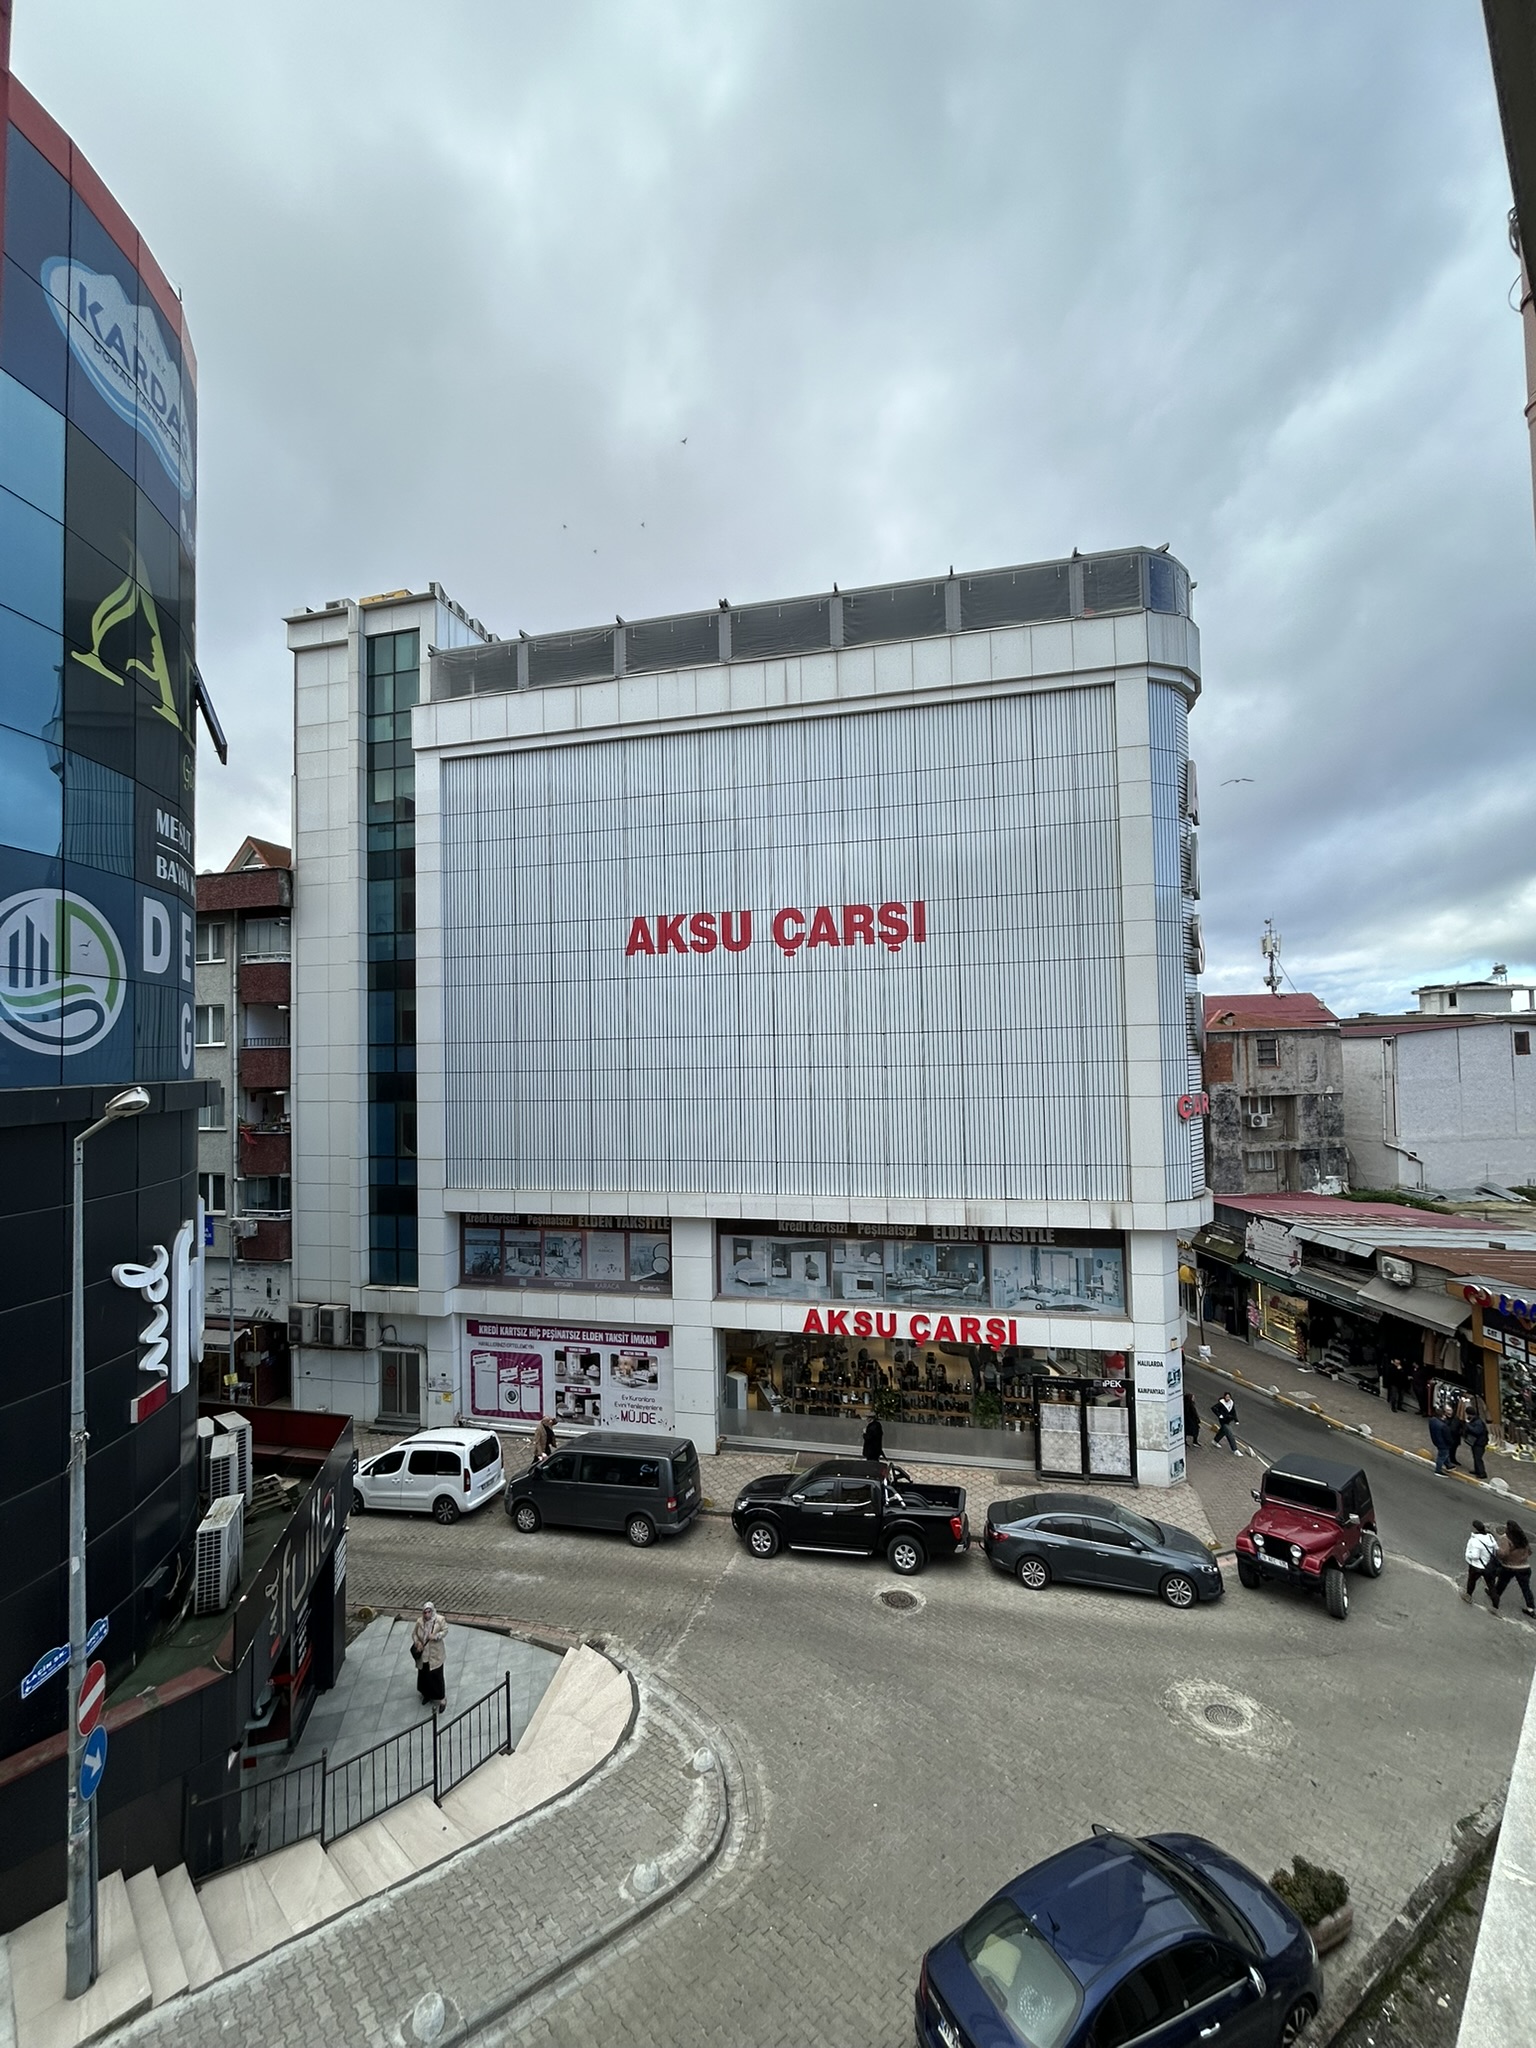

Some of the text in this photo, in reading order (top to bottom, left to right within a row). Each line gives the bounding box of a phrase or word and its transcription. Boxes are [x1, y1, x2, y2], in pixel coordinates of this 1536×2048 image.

[156, 854, 190, 893] BAYAN
[625, 900, 926, 957] AKSU ÇARŞI
[578, 1215, 613, 1228] ELDEN
[933, 1226, 978, 1240] ELDEN
[478, 1324, 657, 1345] KREDİ KARTSIZ HİÇ PEŞİNATSIZ ELDEN TAKSİT İMKANI
[803, 1308, 1017, 1351] AKSU ÇARŞI
[620, 1409, 657, 1425] MÜJDE
